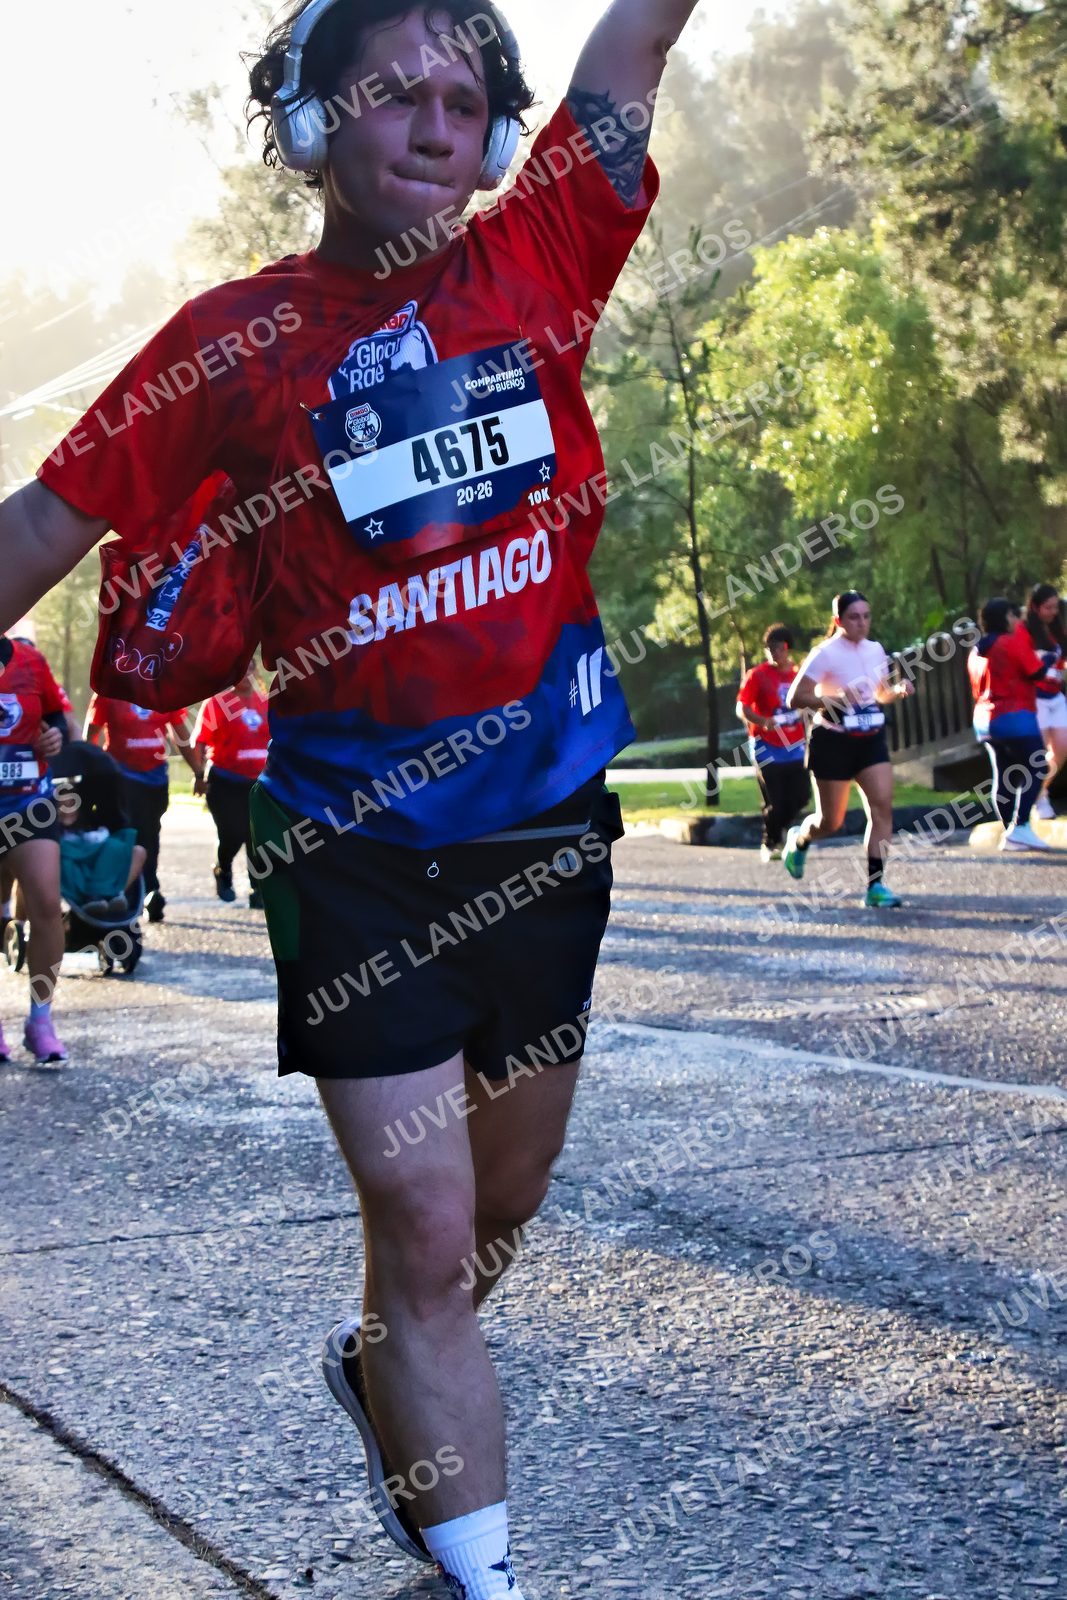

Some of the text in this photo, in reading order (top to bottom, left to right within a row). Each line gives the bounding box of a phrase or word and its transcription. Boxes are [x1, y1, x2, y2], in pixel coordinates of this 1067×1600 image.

[412, 416, 509, 485] 4675
[528, 487, 551, 506] 10K
[347, 529, 552, 645] SANTIAGO
